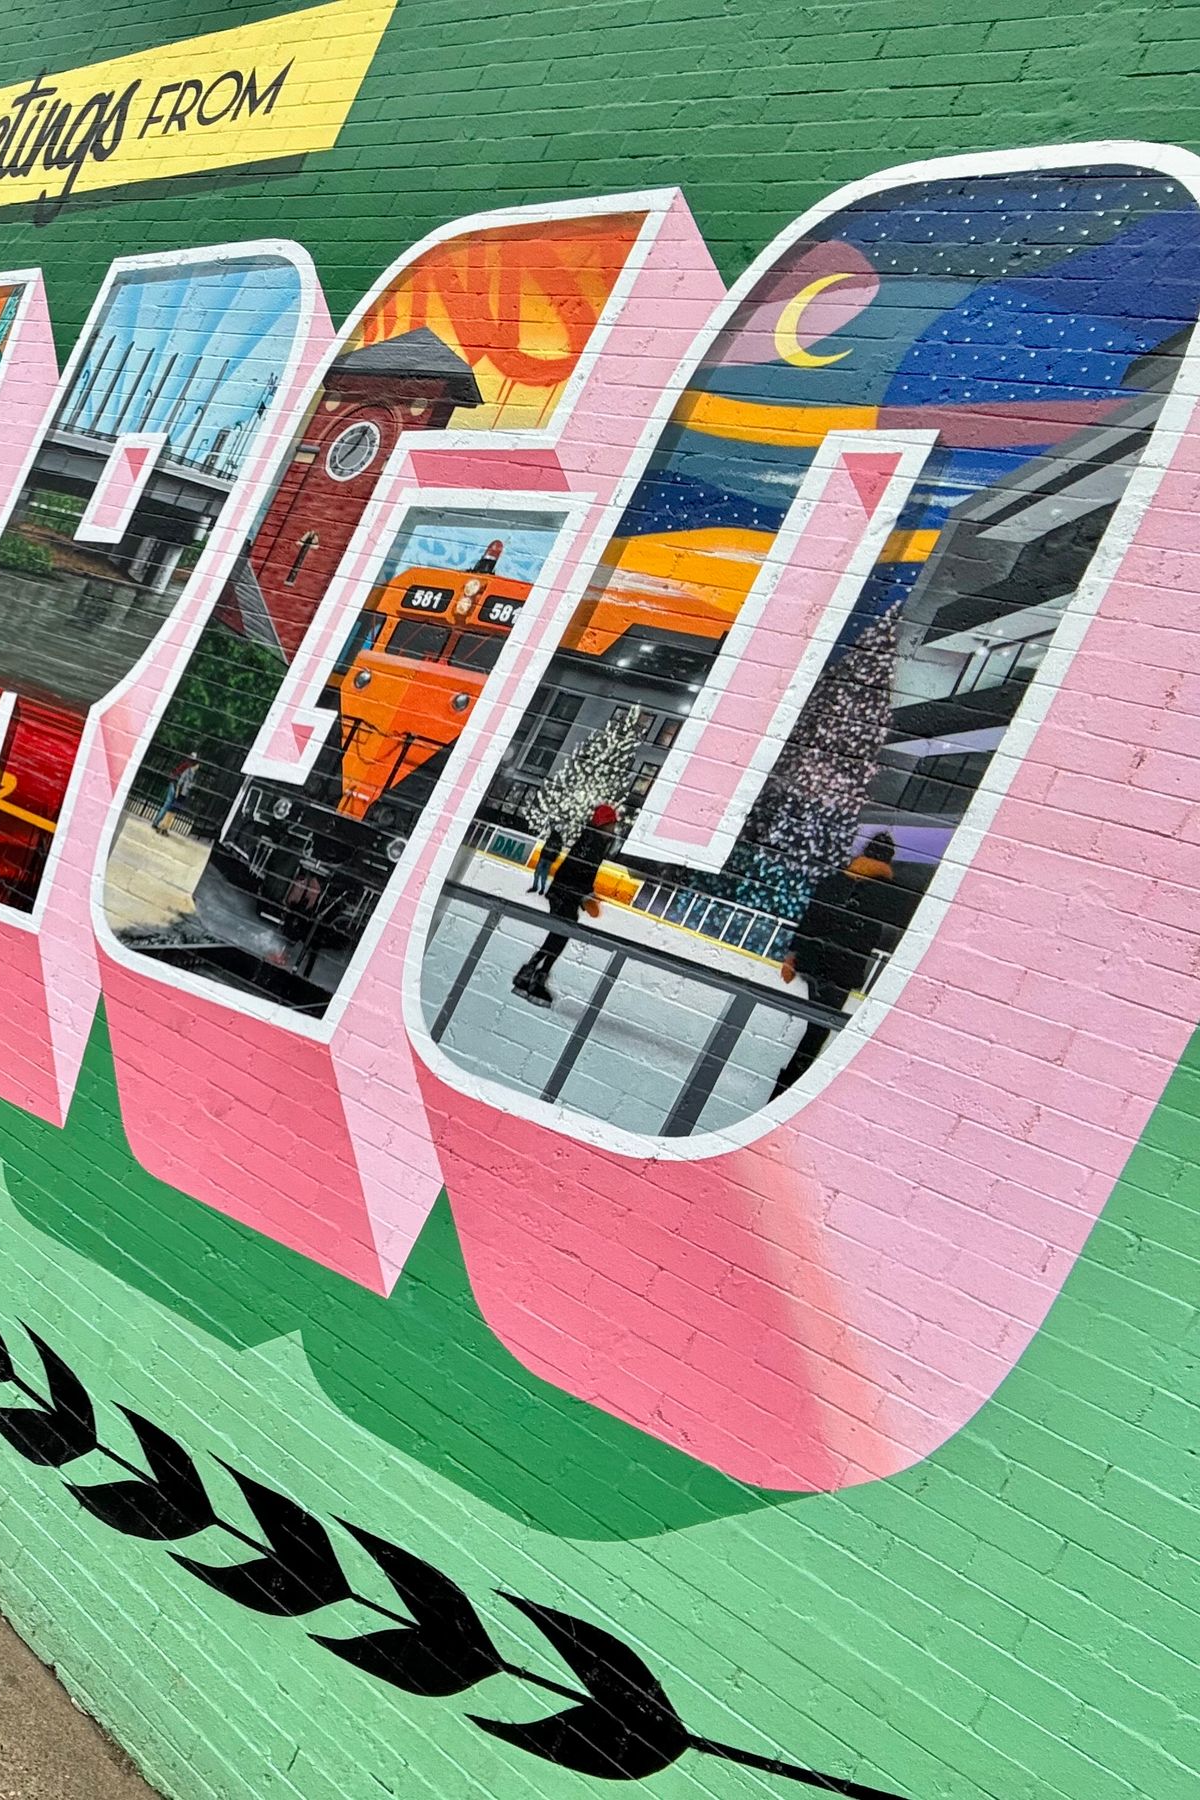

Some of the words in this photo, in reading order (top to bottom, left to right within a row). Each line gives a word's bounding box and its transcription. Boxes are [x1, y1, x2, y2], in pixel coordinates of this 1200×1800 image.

[138, 57, 296, 140] FROM
[411, 590, 443, 610] 581
[492, 835, 526, 860] DNA
